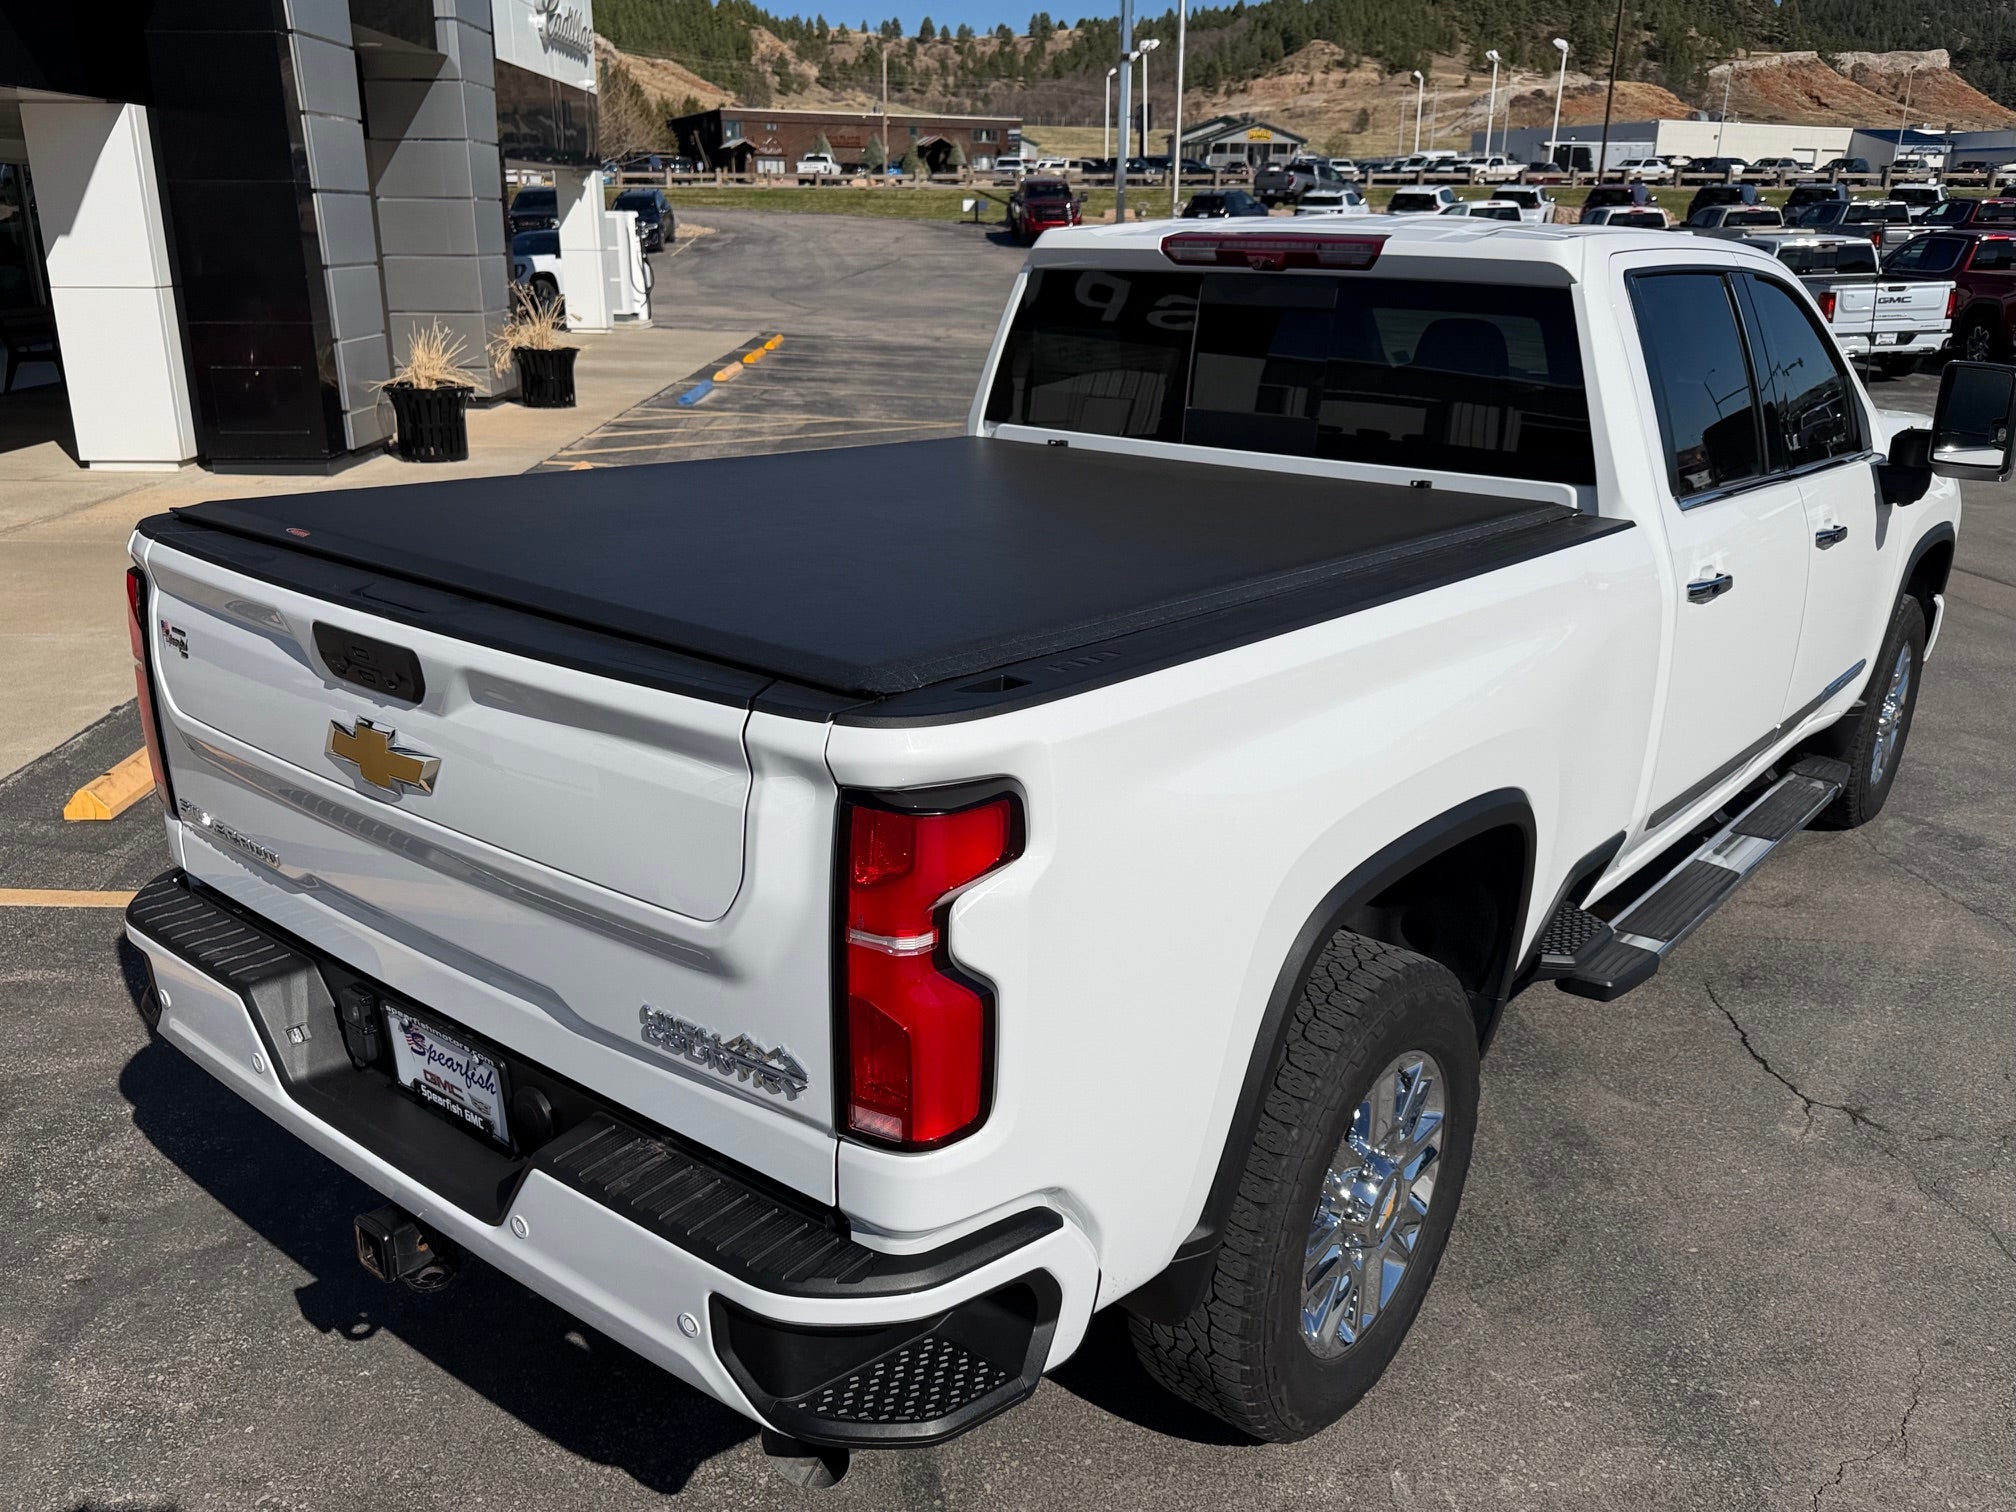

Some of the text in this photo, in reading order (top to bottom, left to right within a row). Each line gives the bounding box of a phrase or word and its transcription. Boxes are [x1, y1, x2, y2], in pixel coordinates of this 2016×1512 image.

[1878, 296, 1912, 304] GMC
[179, 798, 281, 869] SILERADO
[385, 1006, 495, 1066] spearfishmotors.com
[411, 1032, 497, 1095] Spearfish
[423, 1069, 465, 1102] GMC
[421, 1085, 485, 1129] Spearfish GMC
